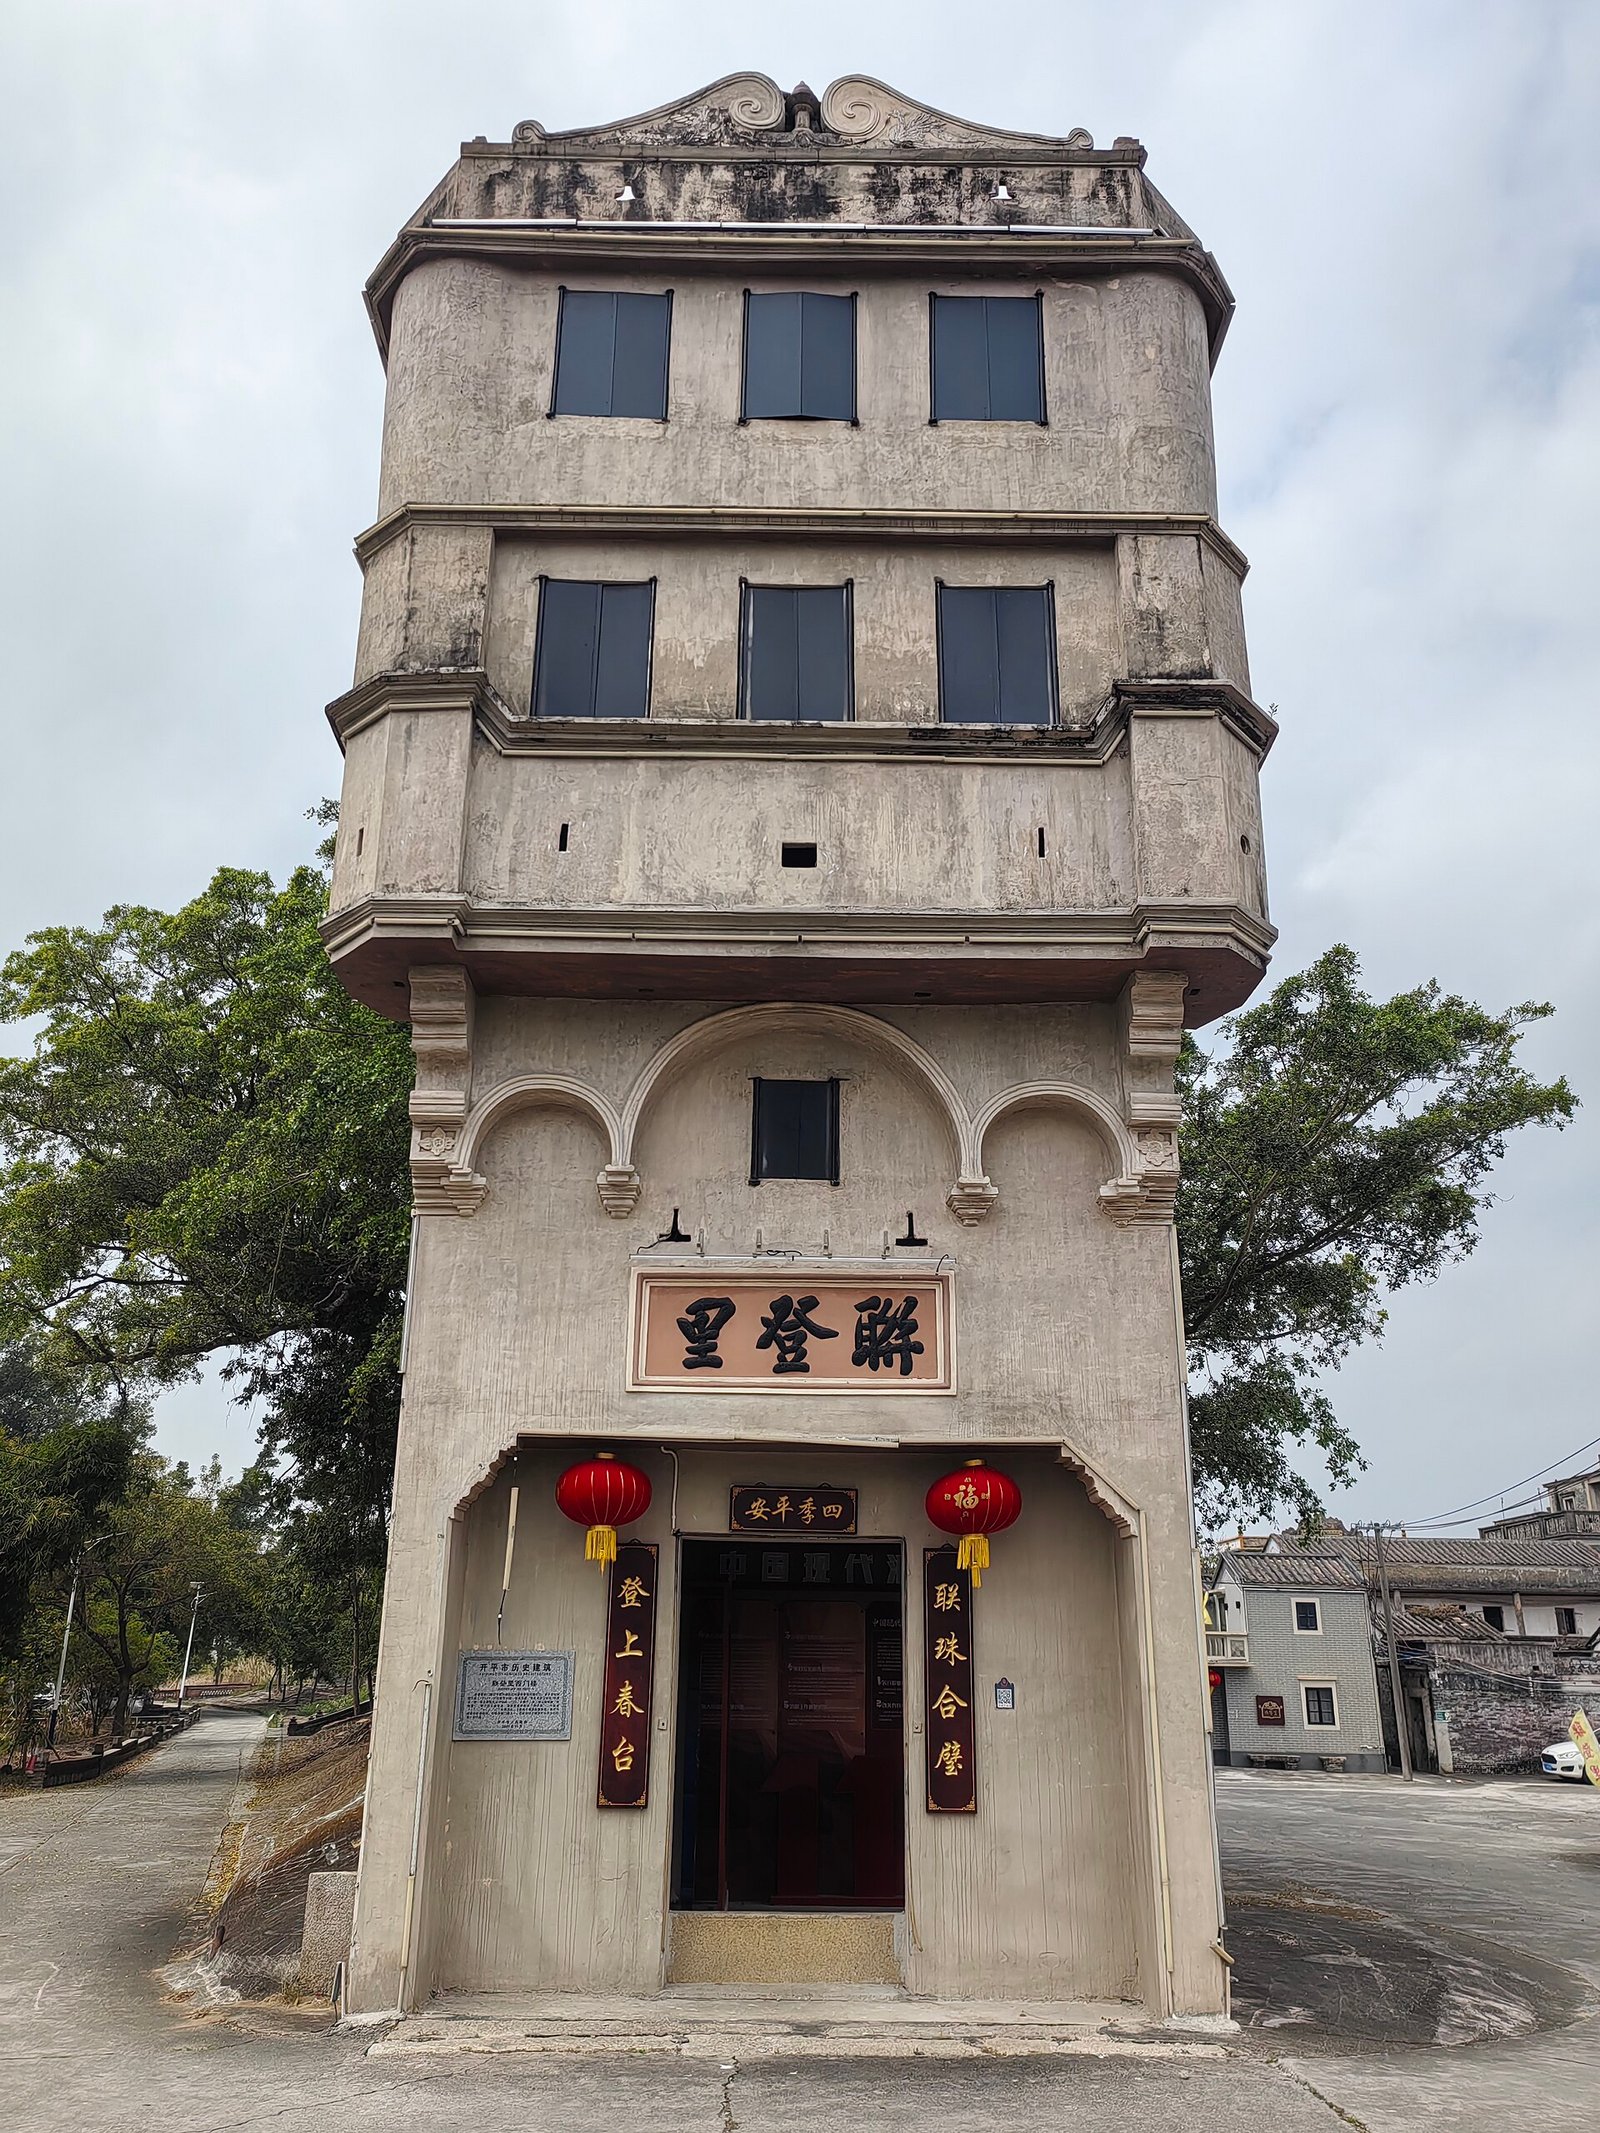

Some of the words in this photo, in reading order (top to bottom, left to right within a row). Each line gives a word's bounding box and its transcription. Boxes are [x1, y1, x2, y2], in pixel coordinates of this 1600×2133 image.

[952, 1484, 979, 1509] 福
[609, 1575, 650, 1772] 登上春台
